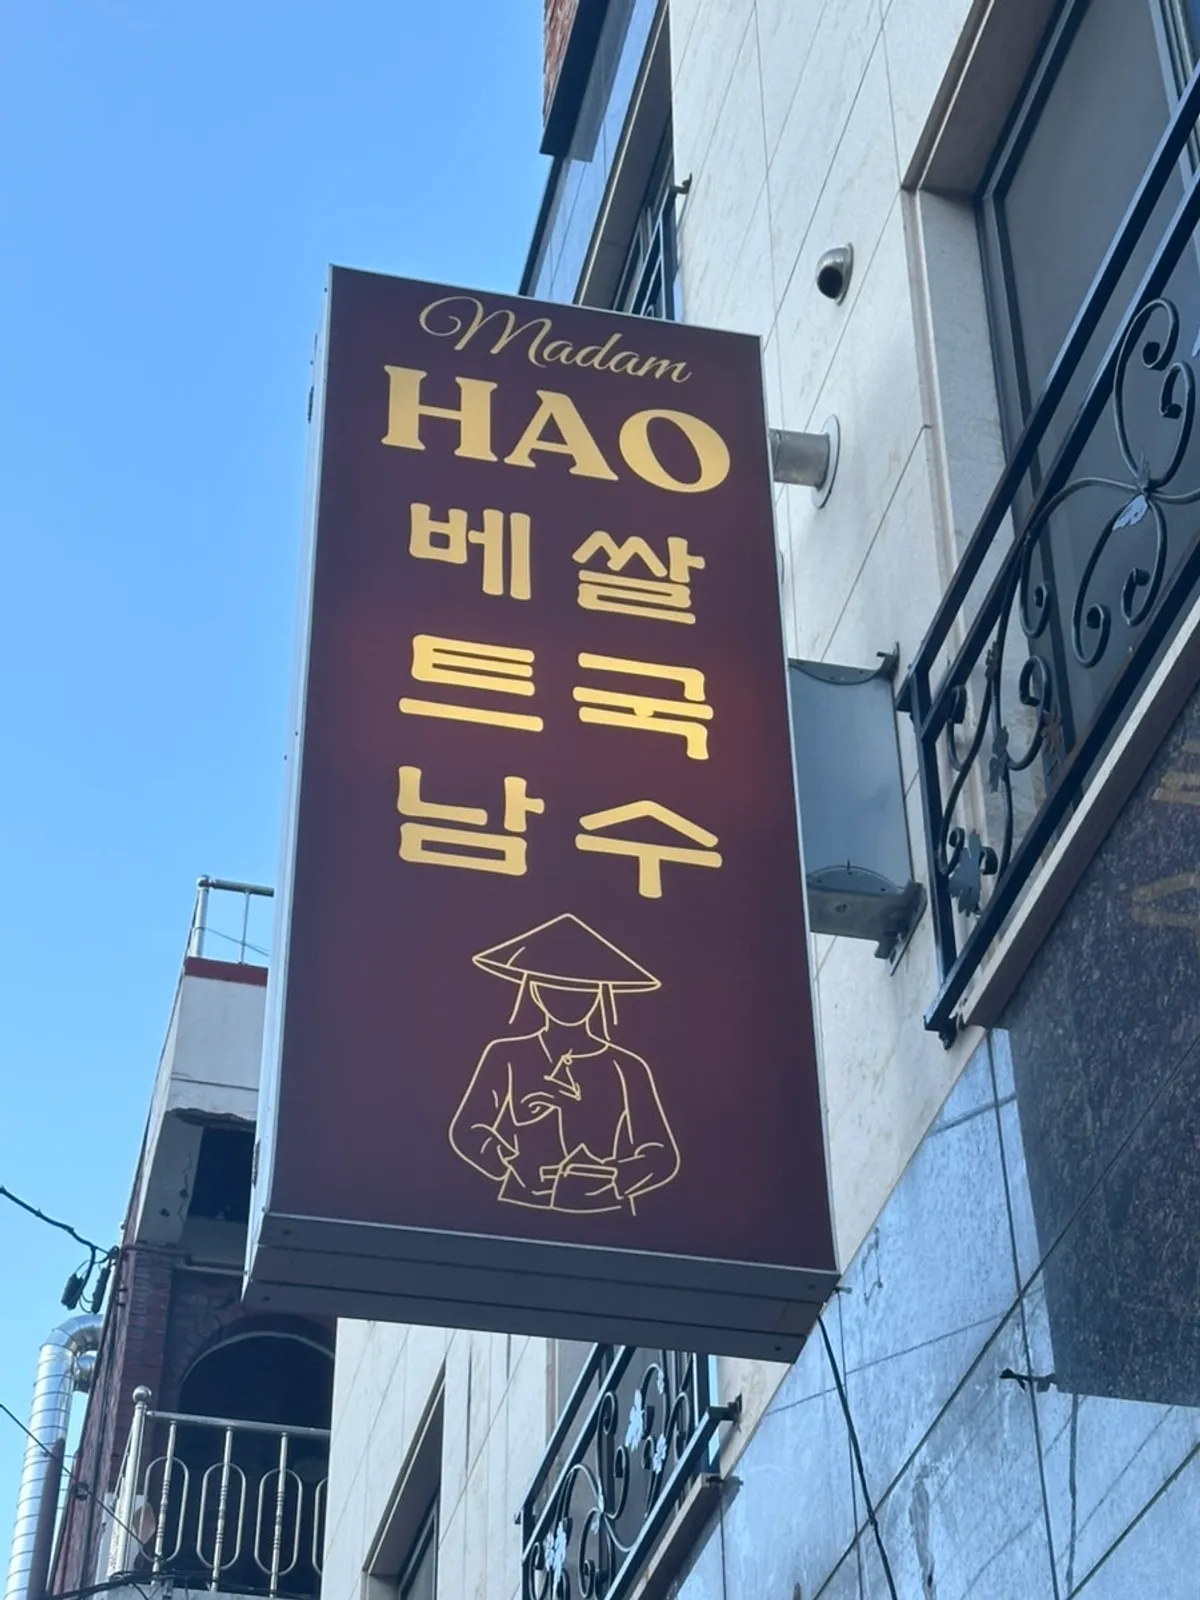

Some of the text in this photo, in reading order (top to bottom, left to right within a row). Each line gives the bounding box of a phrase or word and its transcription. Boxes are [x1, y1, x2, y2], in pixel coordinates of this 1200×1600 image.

[381, 365, 731, 493] HAO
[419, 296, 692, 383] Madam
[396, 503, 546, 877] 베트남
[572, 530, 723, 899] 쌀국수
